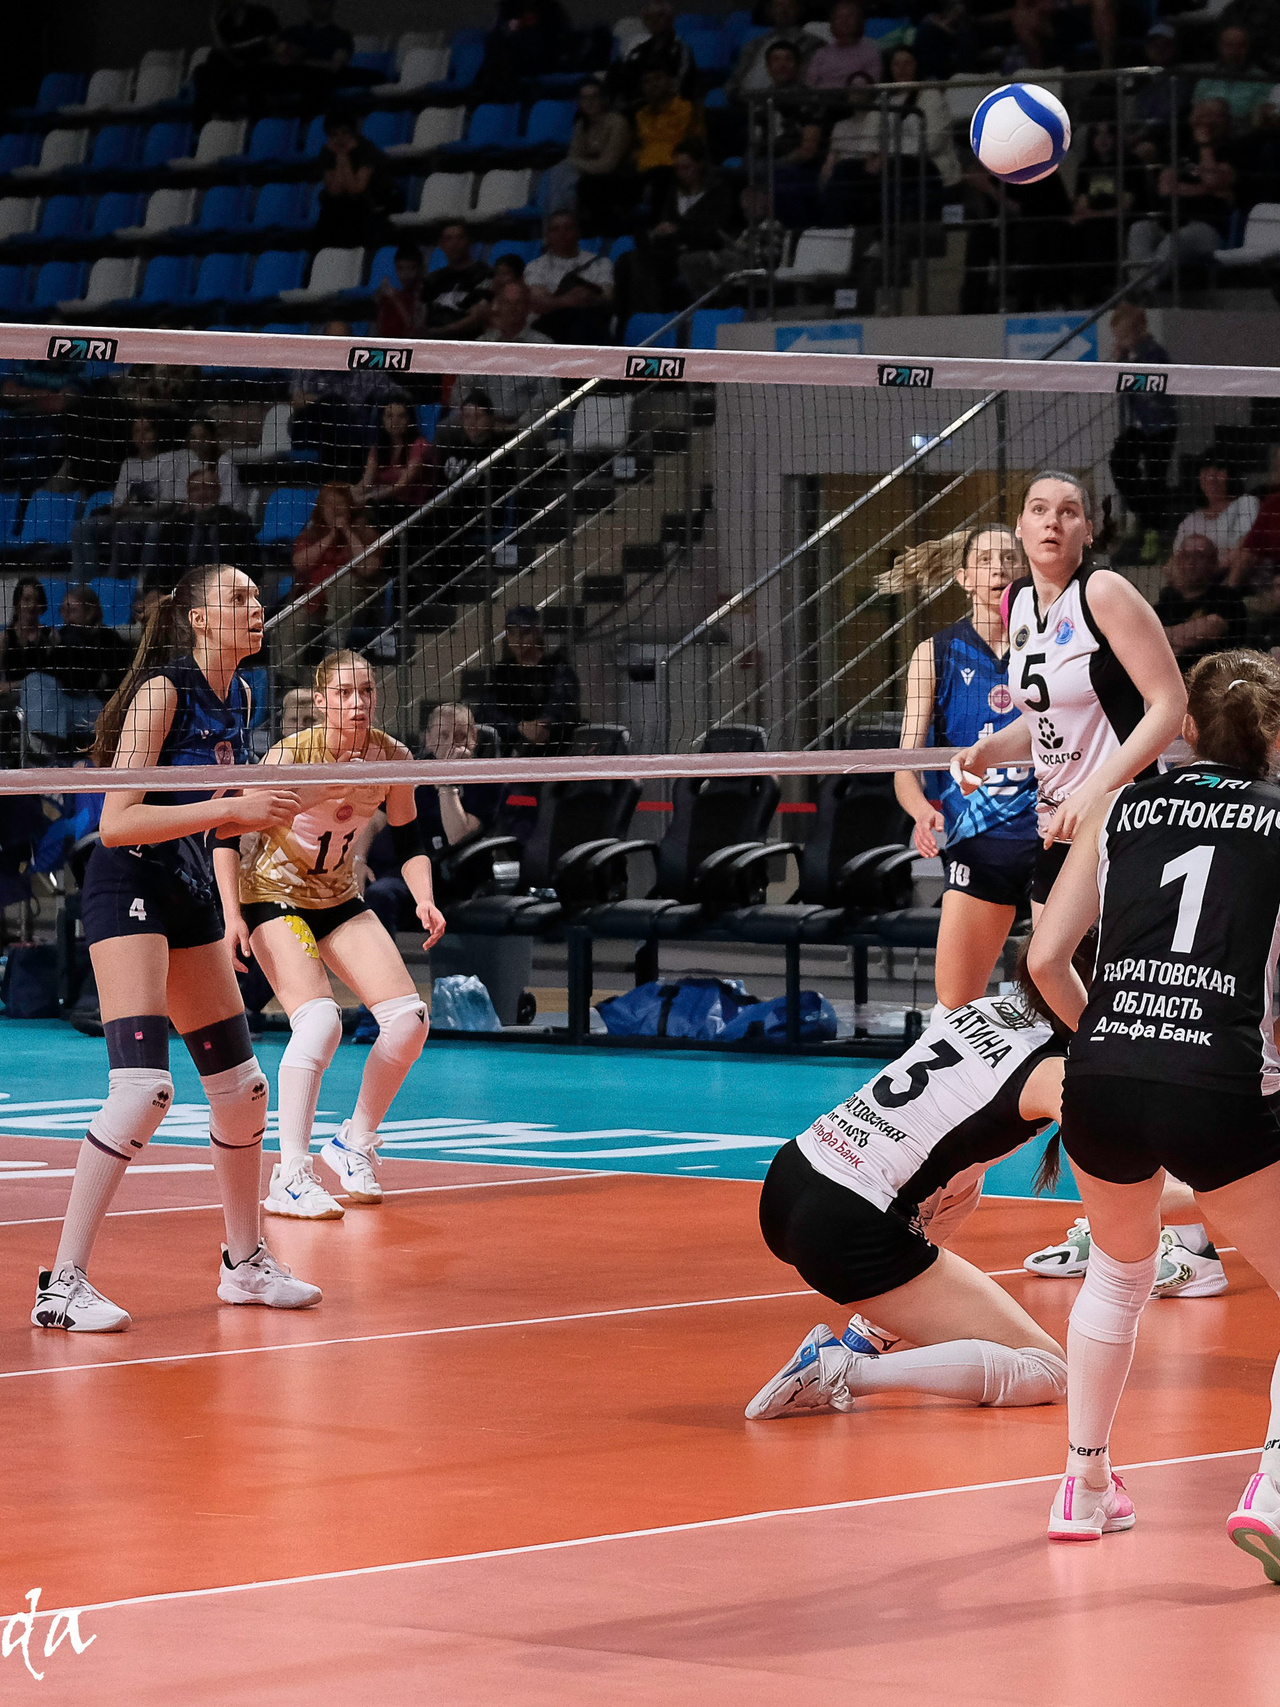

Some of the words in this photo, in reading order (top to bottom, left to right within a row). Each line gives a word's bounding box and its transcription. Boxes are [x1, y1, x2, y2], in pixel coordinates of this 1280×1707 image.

[52, 339, 112, 360] PARI
[352, 349, 407, 368] PARI
[629, 358, 681, 377] PARI
[882, 367, 930, 386] PARI
[1120, 374, 1165, 392] PARI
[1020, 653, 1050, 713] 5
[1174, 773, 1252, 790] PARI
[949, 860, 971, 887] 10
[129, 898, 147, 921] 4
[1160, 845, 1216, 954] 1
[1113, 990, 1204, 1020] ОБЛАСТЬ
[1090, 1016, 1155, 1041] Альфа
[1159, 1023, 1213, 1046] Банк
[872, 1038, 964, 1108] 3
[834, 1140, 865, 1169] Банк
